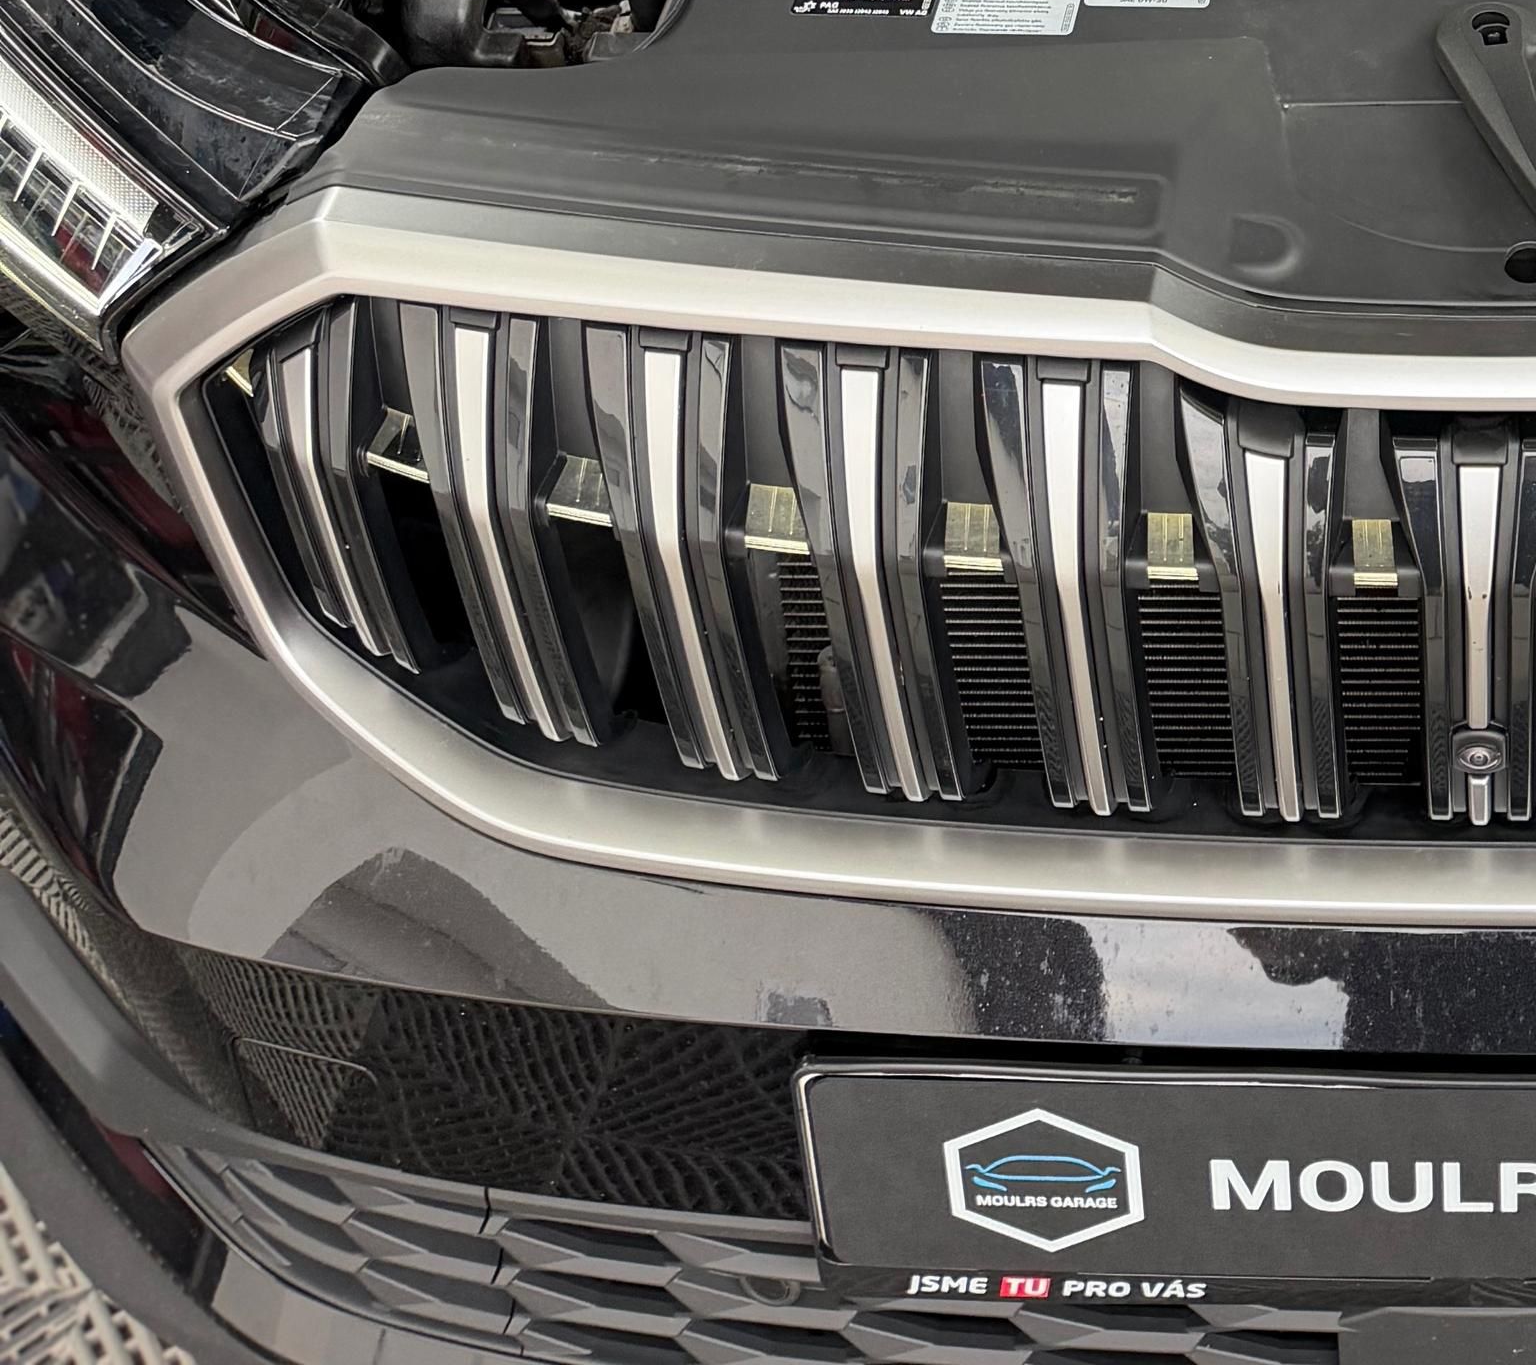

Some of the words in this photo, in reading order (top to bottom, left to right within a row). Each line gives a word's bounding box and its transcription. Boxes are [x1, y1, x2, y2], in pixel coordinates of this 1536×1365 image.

[975, 1194, 1047, 1207] MOULRS
[1050, 1196, 1118, 1208] GARAGE
[907, 1275, 988, 1295] JSME
[1005, 1277, 1048, 1296] TU
[1061, 1279, 1131, 1298] PRO
[1140, 1279, 1208, 1299] VÁS
